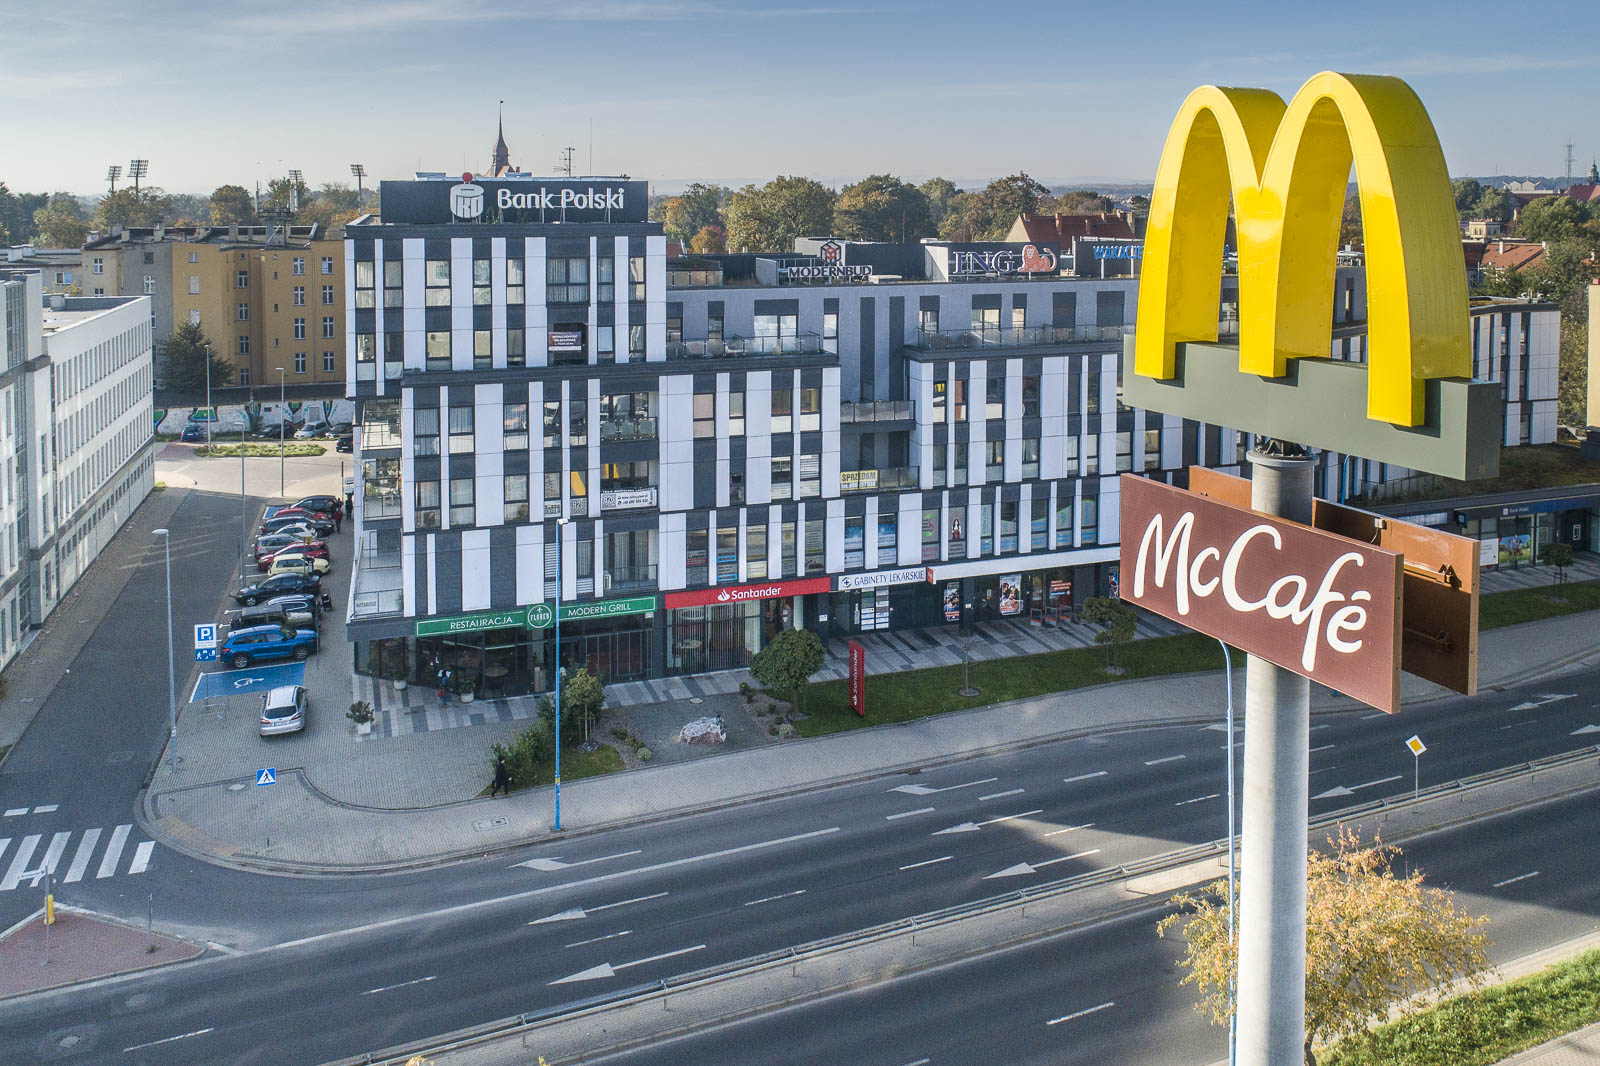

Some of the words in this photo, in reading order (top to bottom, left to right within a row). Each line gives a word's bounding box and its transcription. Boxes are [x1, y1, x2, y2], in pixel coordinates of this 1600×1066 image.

[497, 187, 554, 209] Bank
[561, 187, 625, 209] Polski
[953, 251, 1015, 274] ING
[789, 266, 872, 277] MODERNBUD
[854, 574, 887, 586] GABINETY
[889, 570, 924, 582] LEKARSKIE
[731, 587, 781, 600] Santander
[1134, 512, 1371, 672] McCafé
[568, 605, 606, 616] MODERN
[608, 603, 630, 612] GRILL
[450, 616, 512, 630] RESTAURACJA
